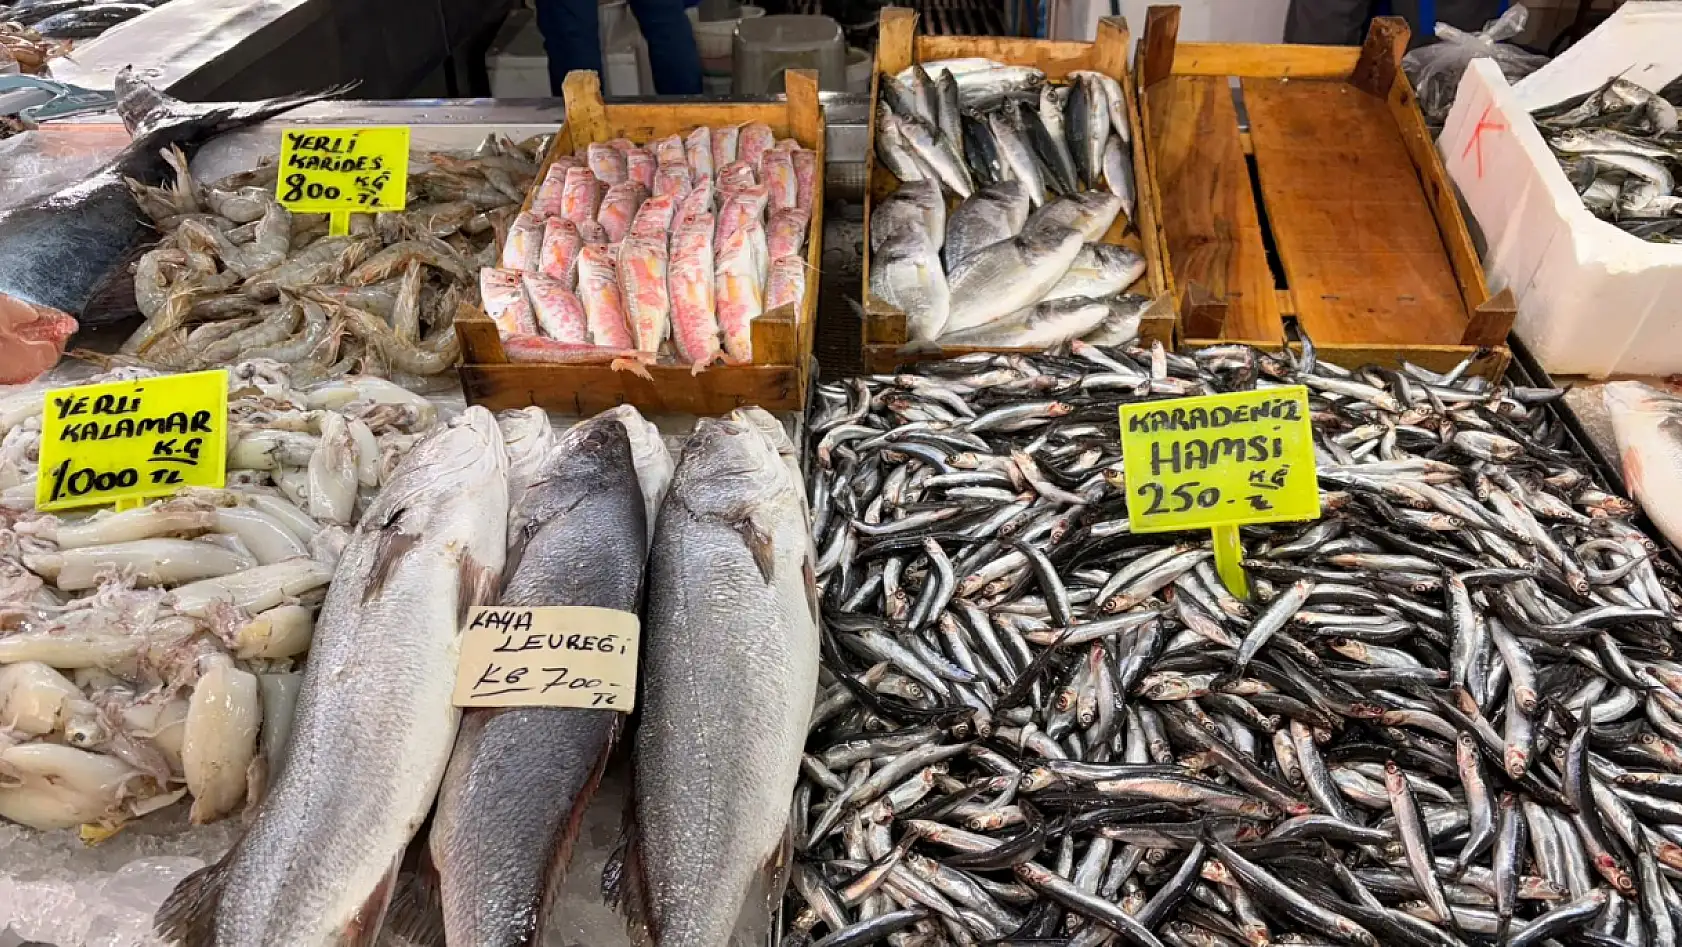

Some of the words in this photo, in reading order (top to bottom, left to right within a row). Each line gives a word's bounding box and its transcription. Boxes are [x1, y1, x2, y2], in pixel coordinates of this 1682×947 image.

[60, 411, 212, 442] KALAMAR
[50, 458, 138, 501] 1.000
[149, 469, 184, 484] TL
[470, 610, 532, 634] KAYA
